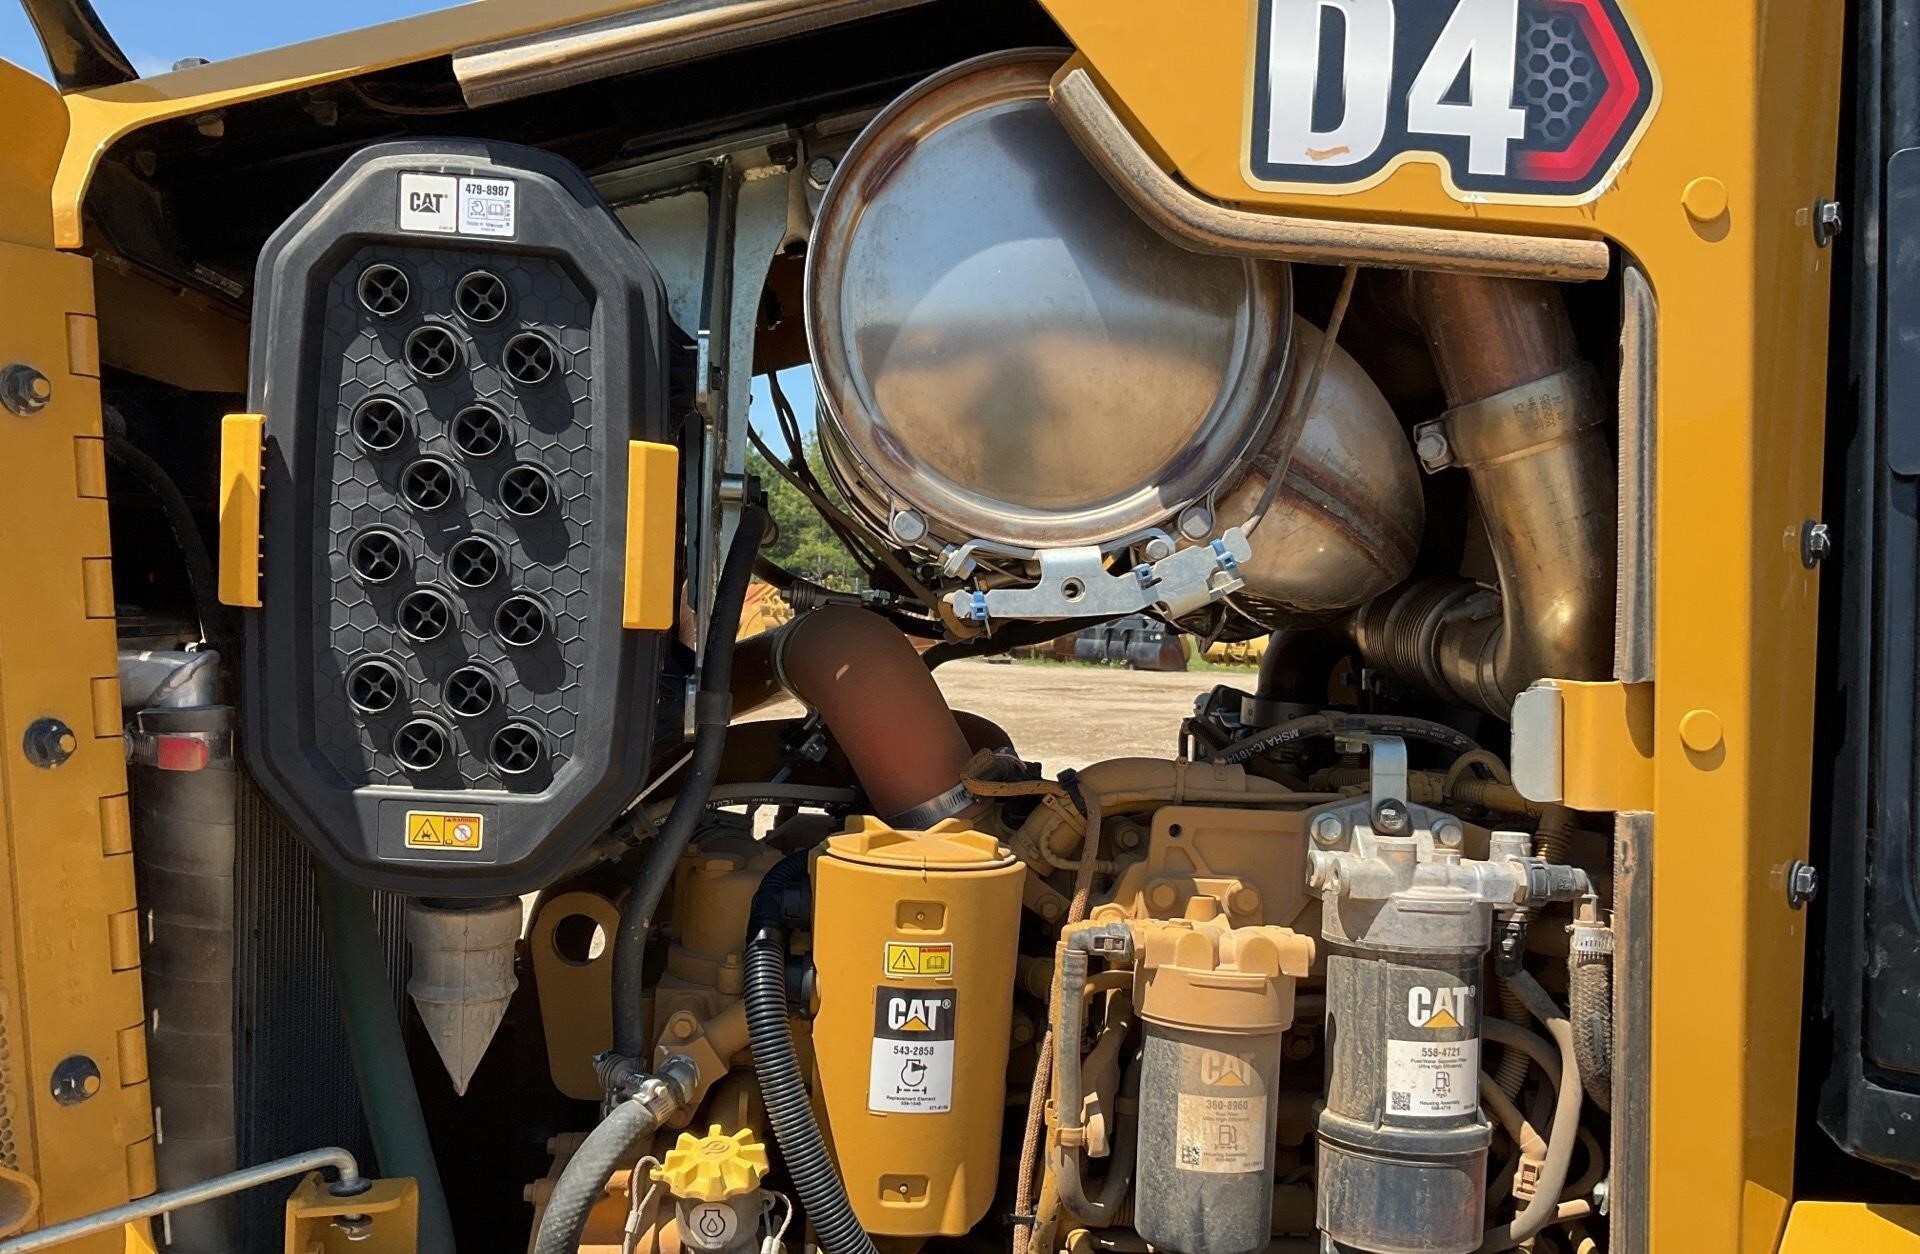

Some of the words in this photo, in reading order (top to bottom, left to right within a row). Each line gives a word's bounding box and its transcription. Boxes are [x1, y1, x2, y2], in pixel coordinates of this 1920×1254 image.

[1267, 0, 1526, 176] D4
[465, 183, 510, 197] 479-8987
[409, 191, 444, 214] CAT
[1265, 728, 1299, 747] MSHA
[887, 997, 942, 1031] CAT
[1407, 986, 1469, 1028] CAT
[893, 1046, 934, 1056] 543-2858
[1421, 1047, 1460, 1058] 558-4721
[1201, 1052, 1255, 1086] CAT
[1206, 1099, 1248, 1110] 360-8960
